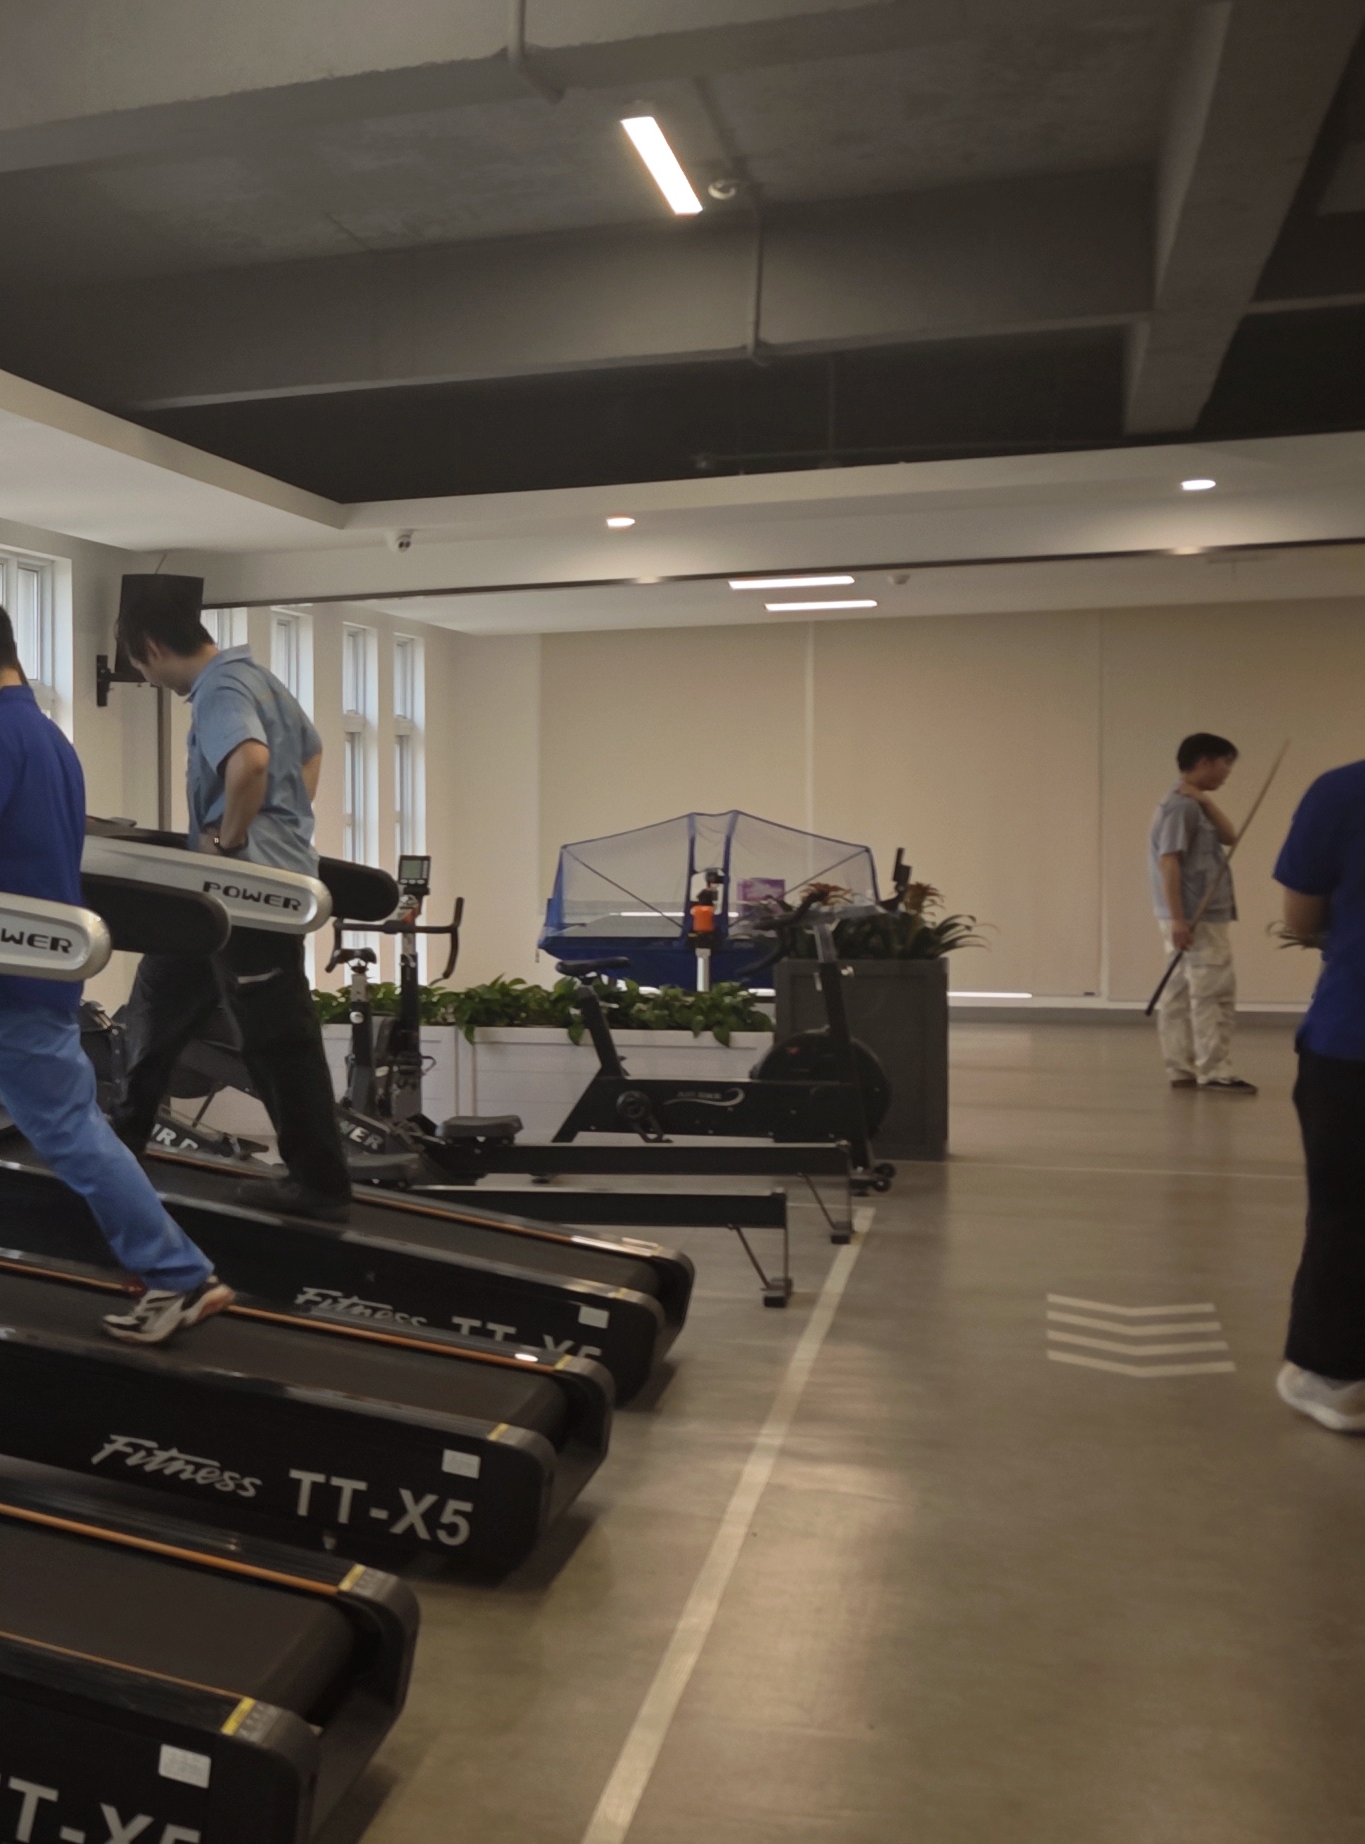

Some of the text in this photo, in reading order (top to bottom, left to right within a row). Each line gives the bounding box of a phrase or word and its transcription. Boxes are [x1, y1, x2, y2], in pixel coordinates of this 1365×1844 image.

[203, 881, 302, 912] POWER
[91, 1434, 474, 1548] Fitness TT-X5
